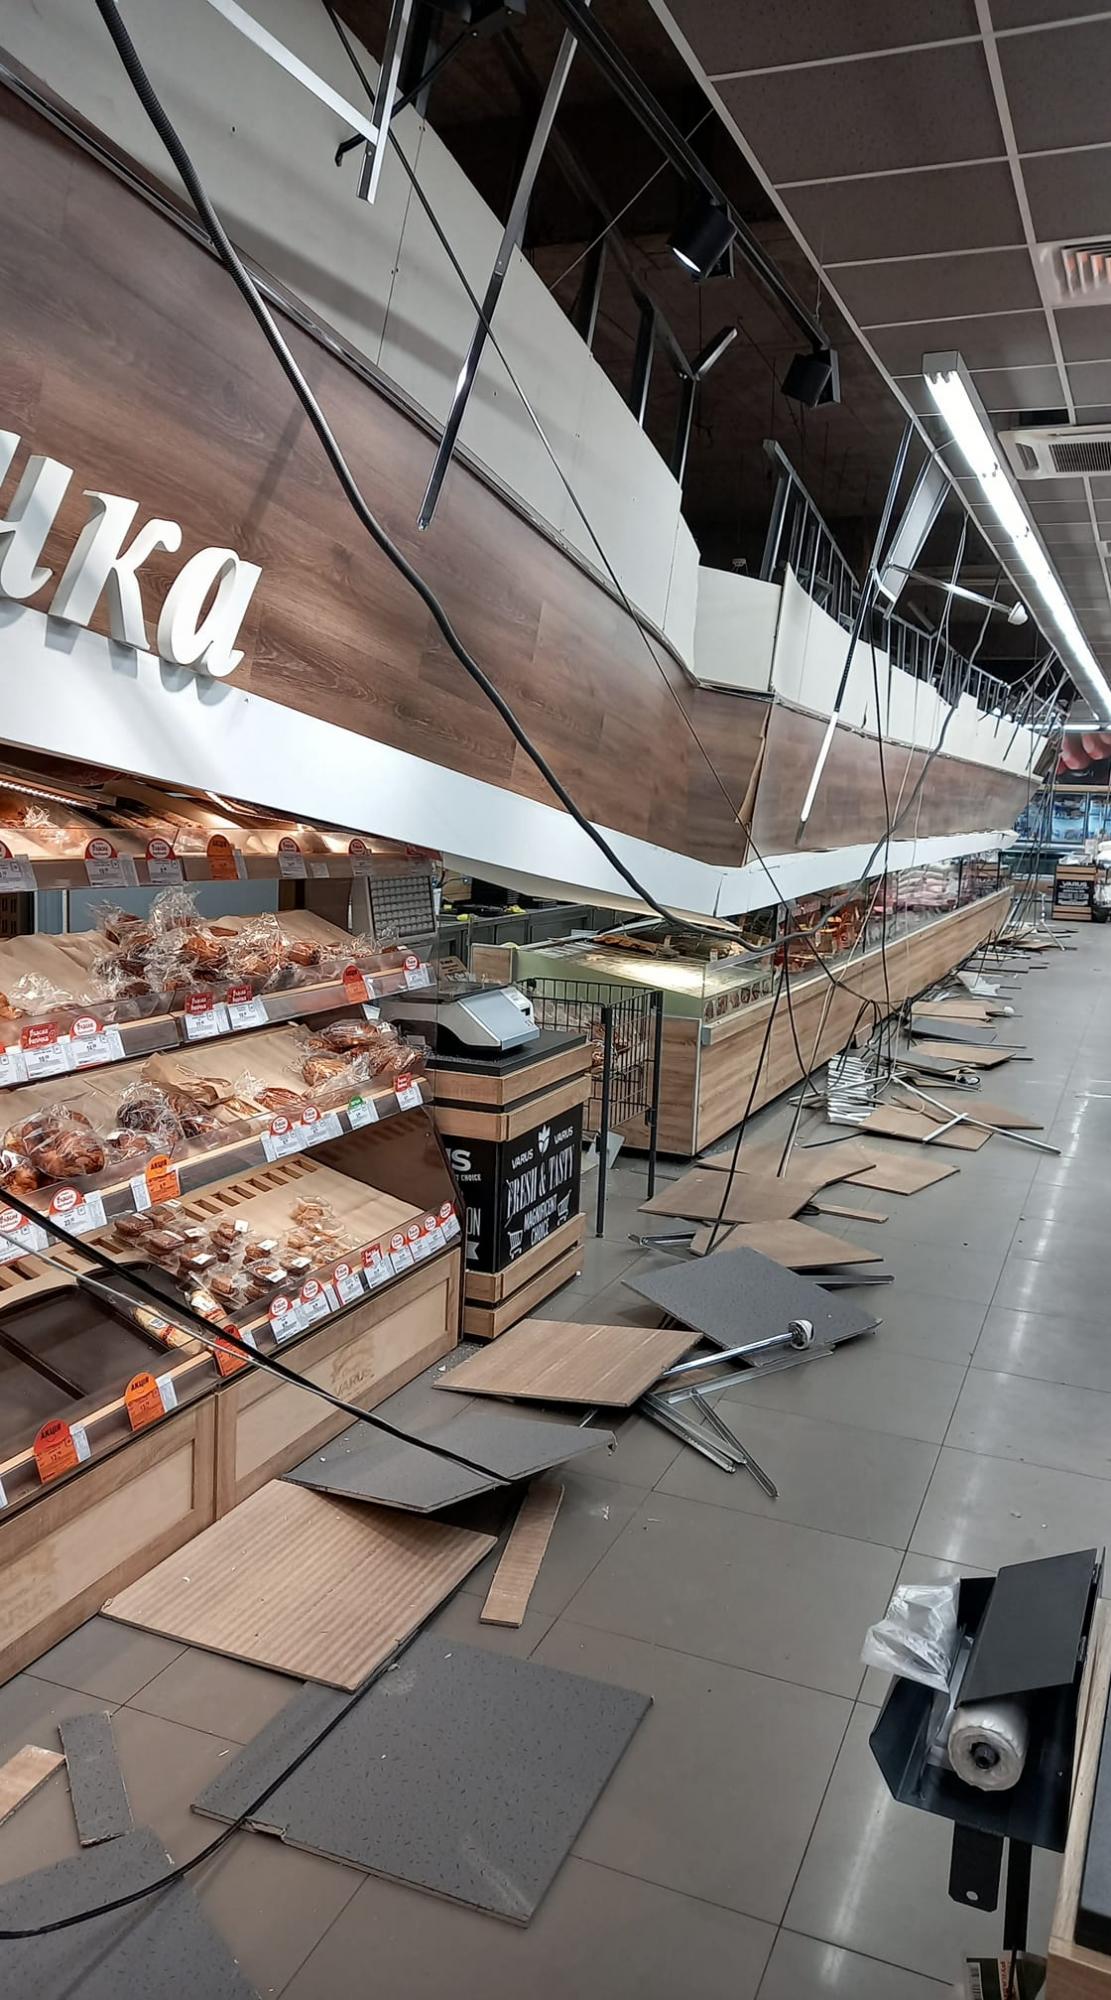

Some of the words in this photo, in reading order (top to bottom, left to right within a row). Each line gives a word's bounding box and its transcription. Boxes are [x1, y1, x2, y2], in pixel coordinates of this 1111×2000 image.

[554, 1126, 574, 1145] VARUS
[511, 1148, 534, 1169] VARUS
[461, 1173, 482, 1181] CHOICE
[506, 1166, 538, 1221] FRESH
[538, 1161, 547, 1197] &
[548, 1144, 575, 1191] TASTY
[524, 1193, 558, 1233] MAGNIFICENT
[531, 1218, 550, 1246] CHOICE
